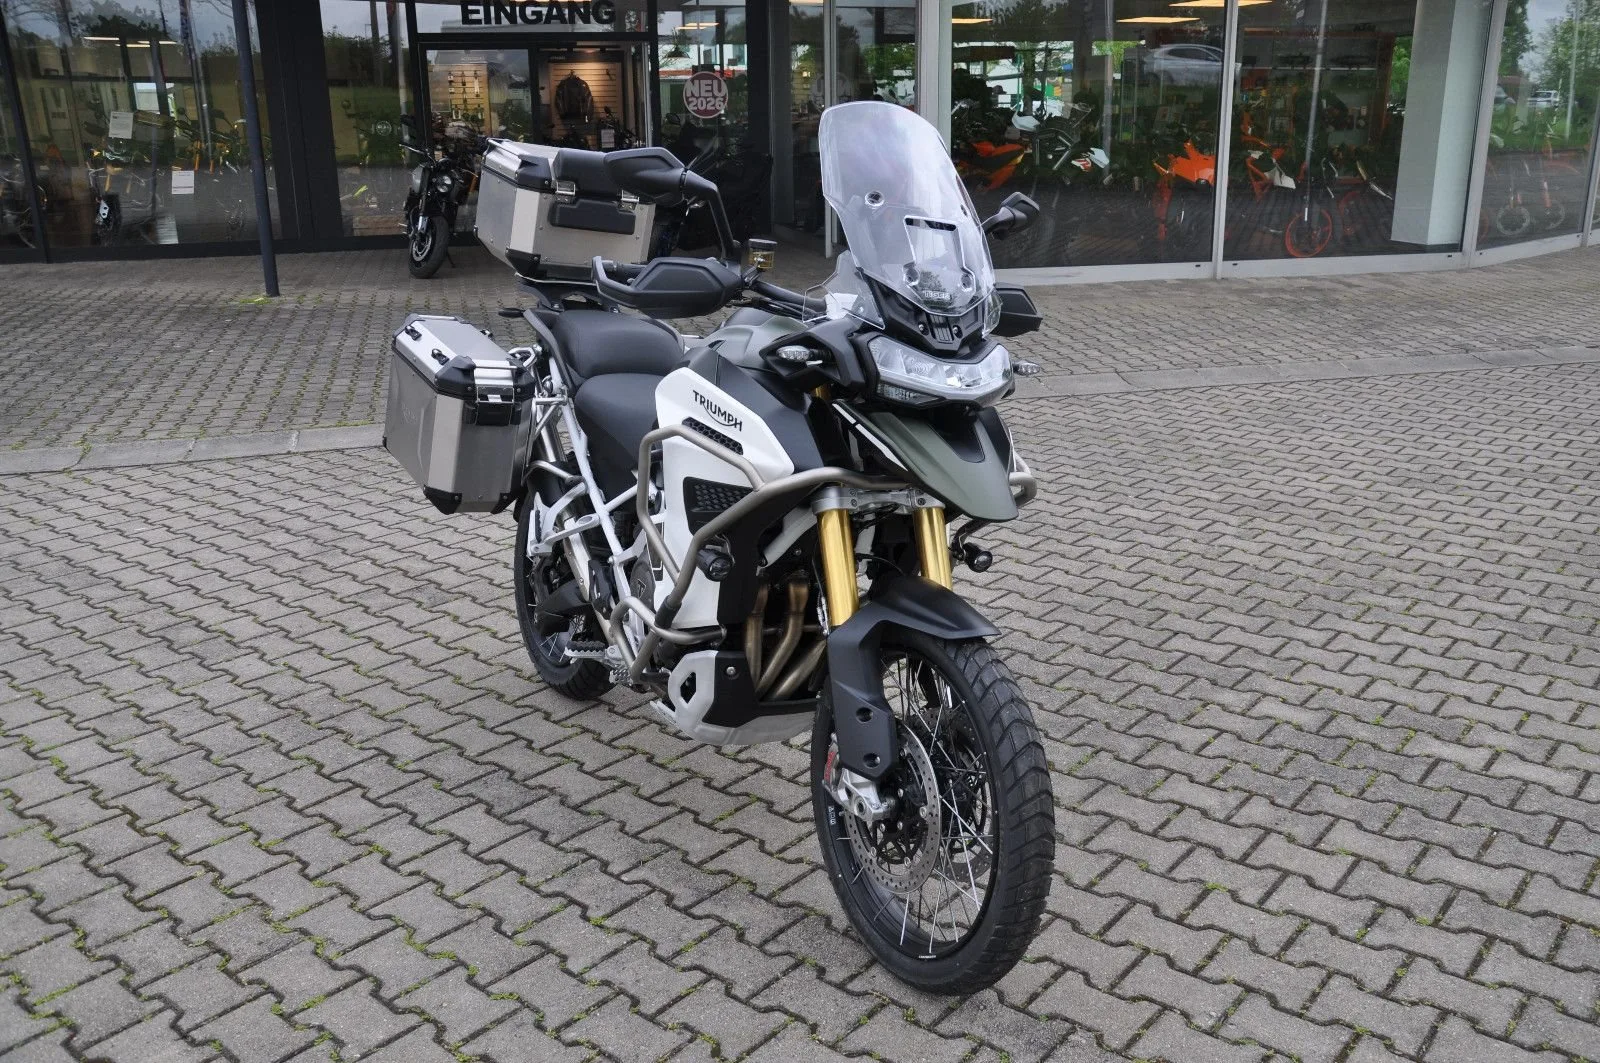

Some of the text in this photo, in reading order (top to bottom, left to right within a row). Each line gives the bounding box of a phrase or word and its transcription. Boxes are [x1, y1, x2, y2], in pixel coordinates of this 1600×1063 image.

[461, 0, 617, 26] EINGANG
[685, 79, 727, 97] NEU
[688, 97, 725, 111] 2026
[692, 389, 743, 432] TRIUMPH
